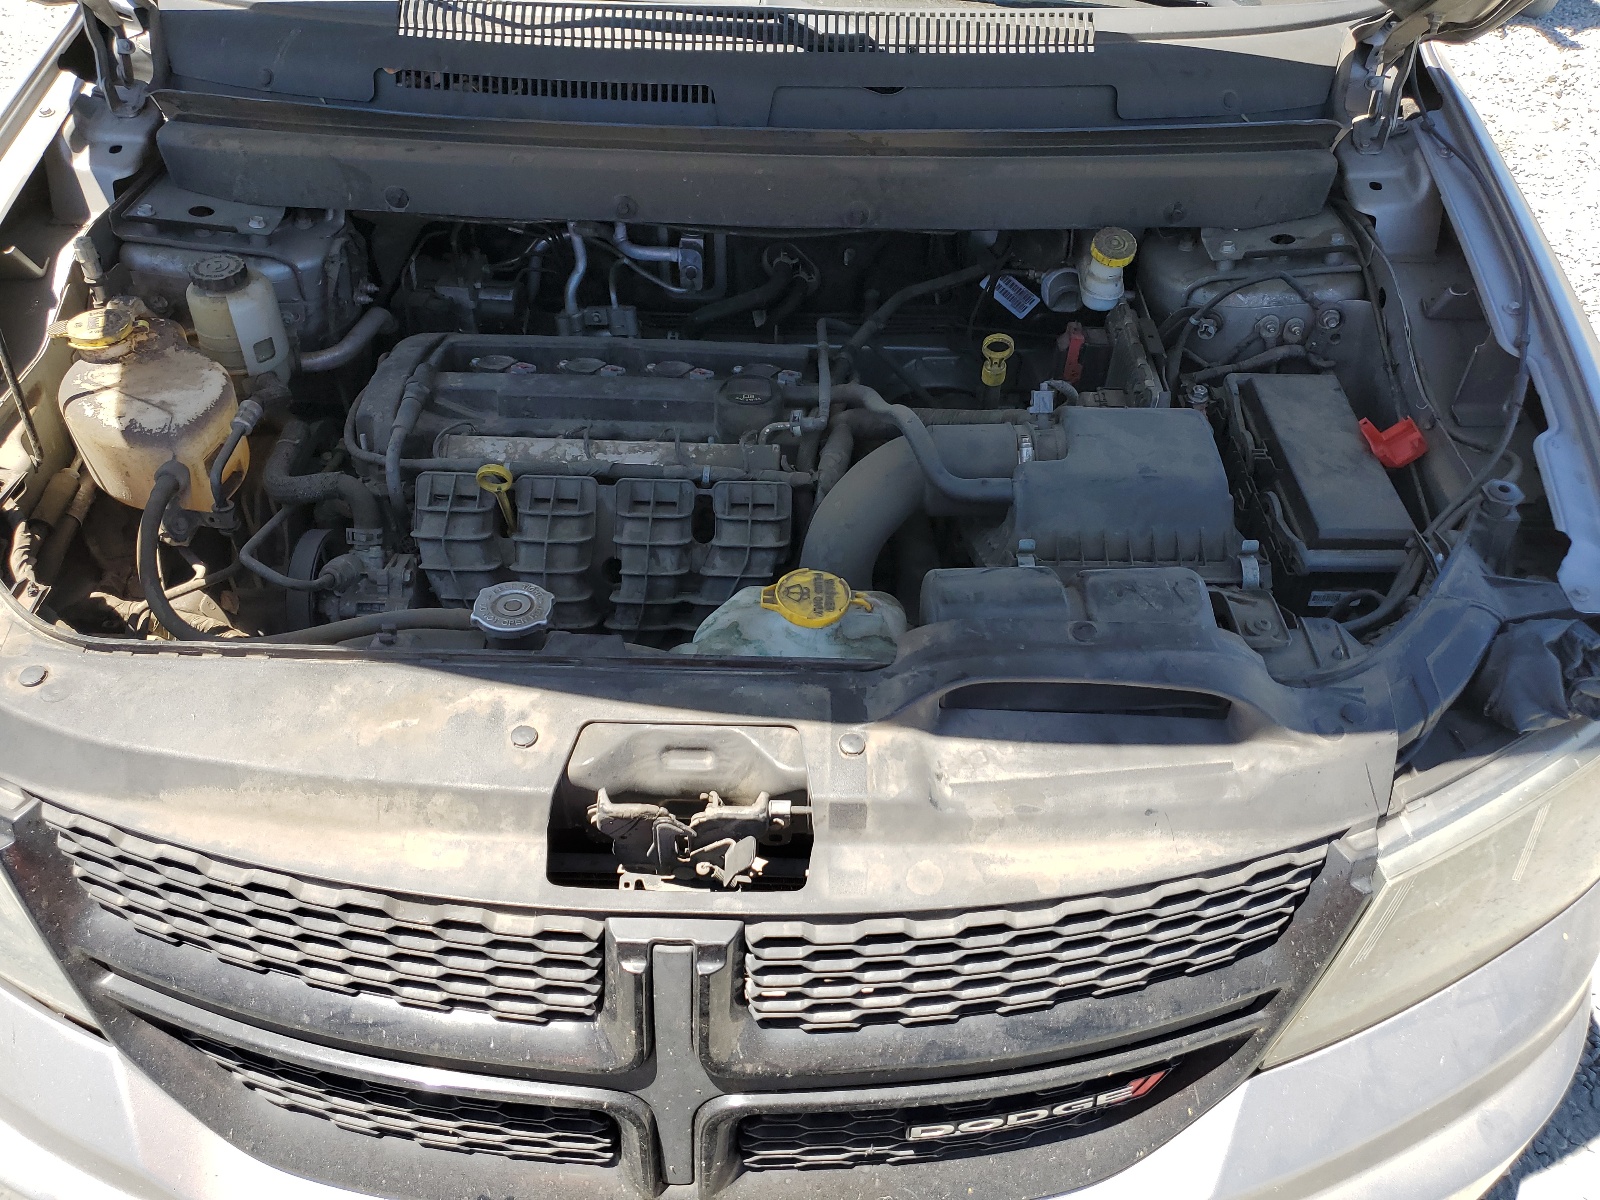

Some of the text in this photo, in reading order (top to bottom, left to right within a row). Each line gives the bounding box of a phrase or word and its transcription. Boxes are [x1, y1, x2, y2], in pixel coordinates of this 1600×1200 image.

[522, 583, 544, 600] TIGHT
[813, 572, 823, 617] FLUID ONLY
[501, 618, 527, 626] OPEN
[905, 1084, 1134, 1141] DODGE
